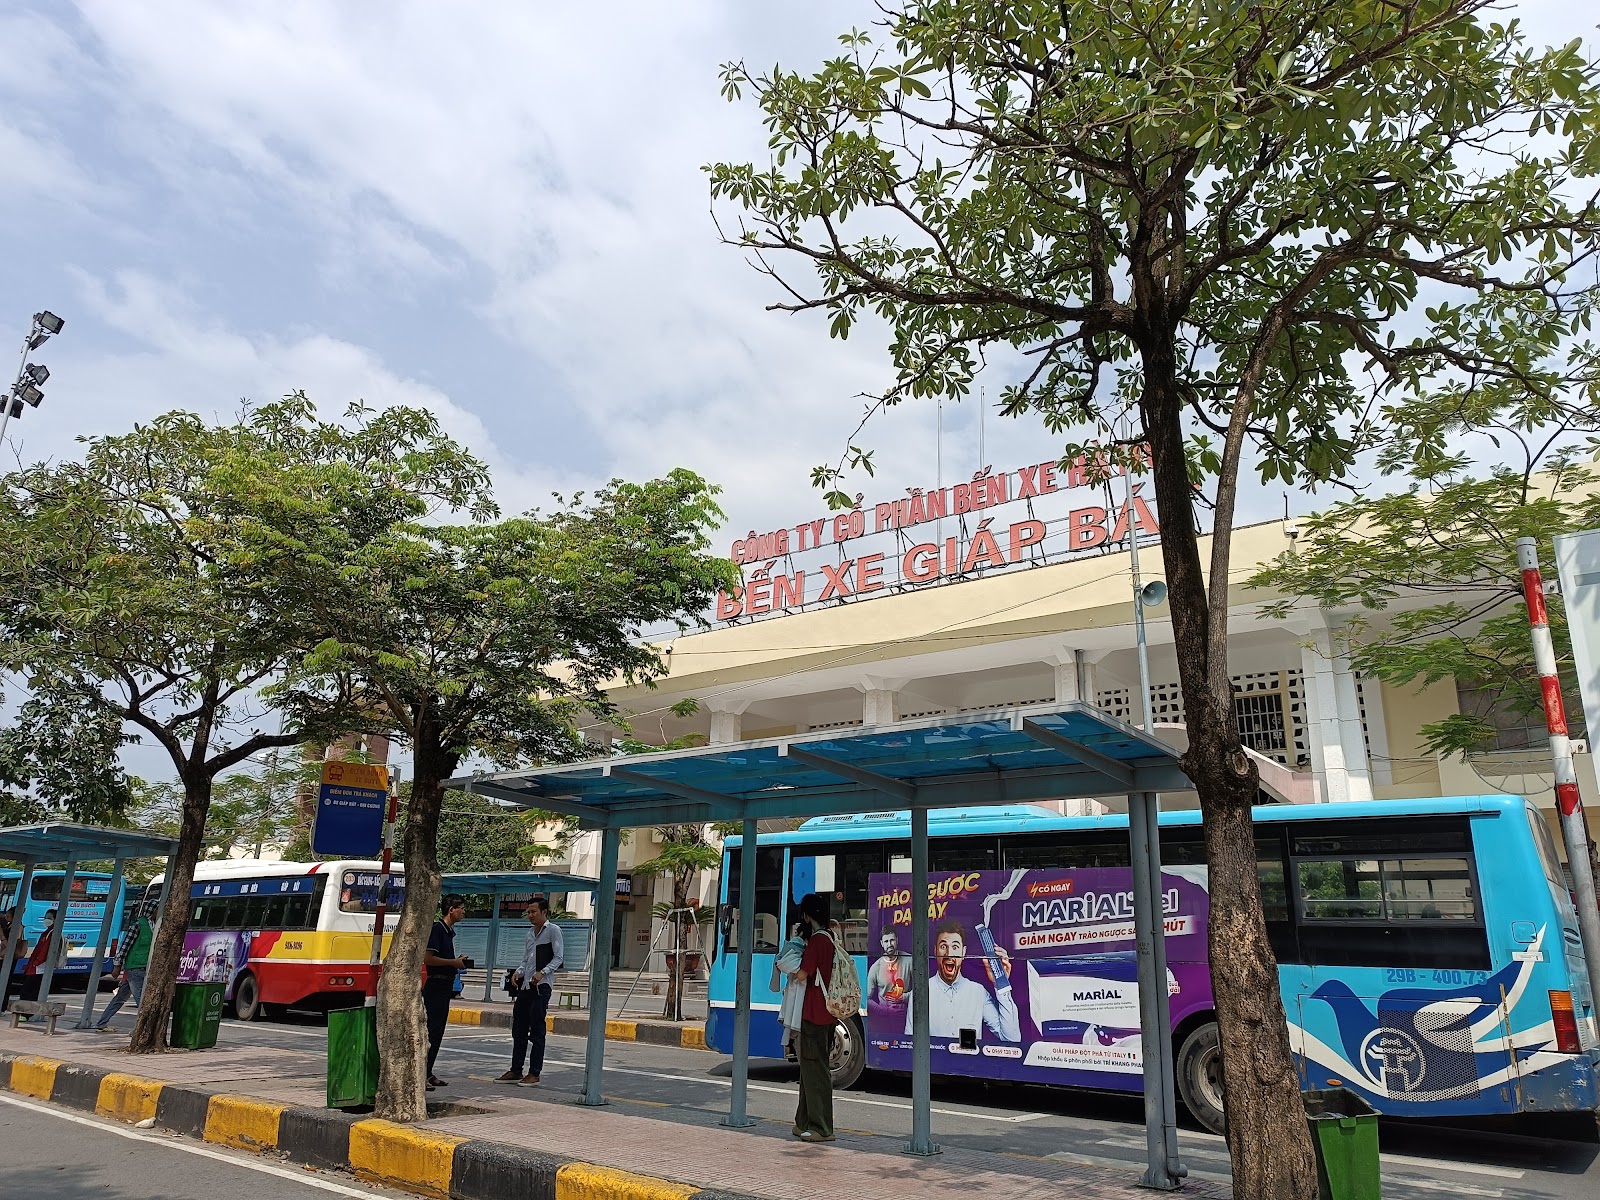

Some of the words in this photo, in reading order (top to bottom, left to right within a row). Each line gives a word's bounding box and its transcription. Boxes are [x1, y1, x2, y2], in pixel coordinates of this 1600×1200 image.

[731, 530, 789, 566] CÔNG
[796, 517, 826, 551] TY
[833, 492, 866, 543] CỔ
[875, 487, 947, 532] PHẦN
[953, 464, 1007, 515] BẾN
[1017, 459, 1058, 500] XE
[716, 559, 805, 620] BẾN
[818, 551, 885, 602] XE
[902, 517, 1047, 584] GIÁP
[1069, 481, 1161, 552] BÁ
[877, 889, 911, 909] TRÀO
[928, 873, 980, 900] GƯỢC
[1038, 883, 1050, 893] CÓ
[1050, 882, 1071, 893] NGAY
[894, 908, 911, 926] DẠ
[928, 900, 948, 919] ÀY
[1019, 932, 1046, 946] GIẢM
[1050, 931, 1077, 943] NGAY
[1079, 931, 1098, 941] TRÀO
[1099, 927, 1126, 939] NGƯỢC
[1163, 919, 1186, 932] HÚT
[1387, 968, 1417, 983] 29B
[1432, 969, 1488, 985] 400.73
